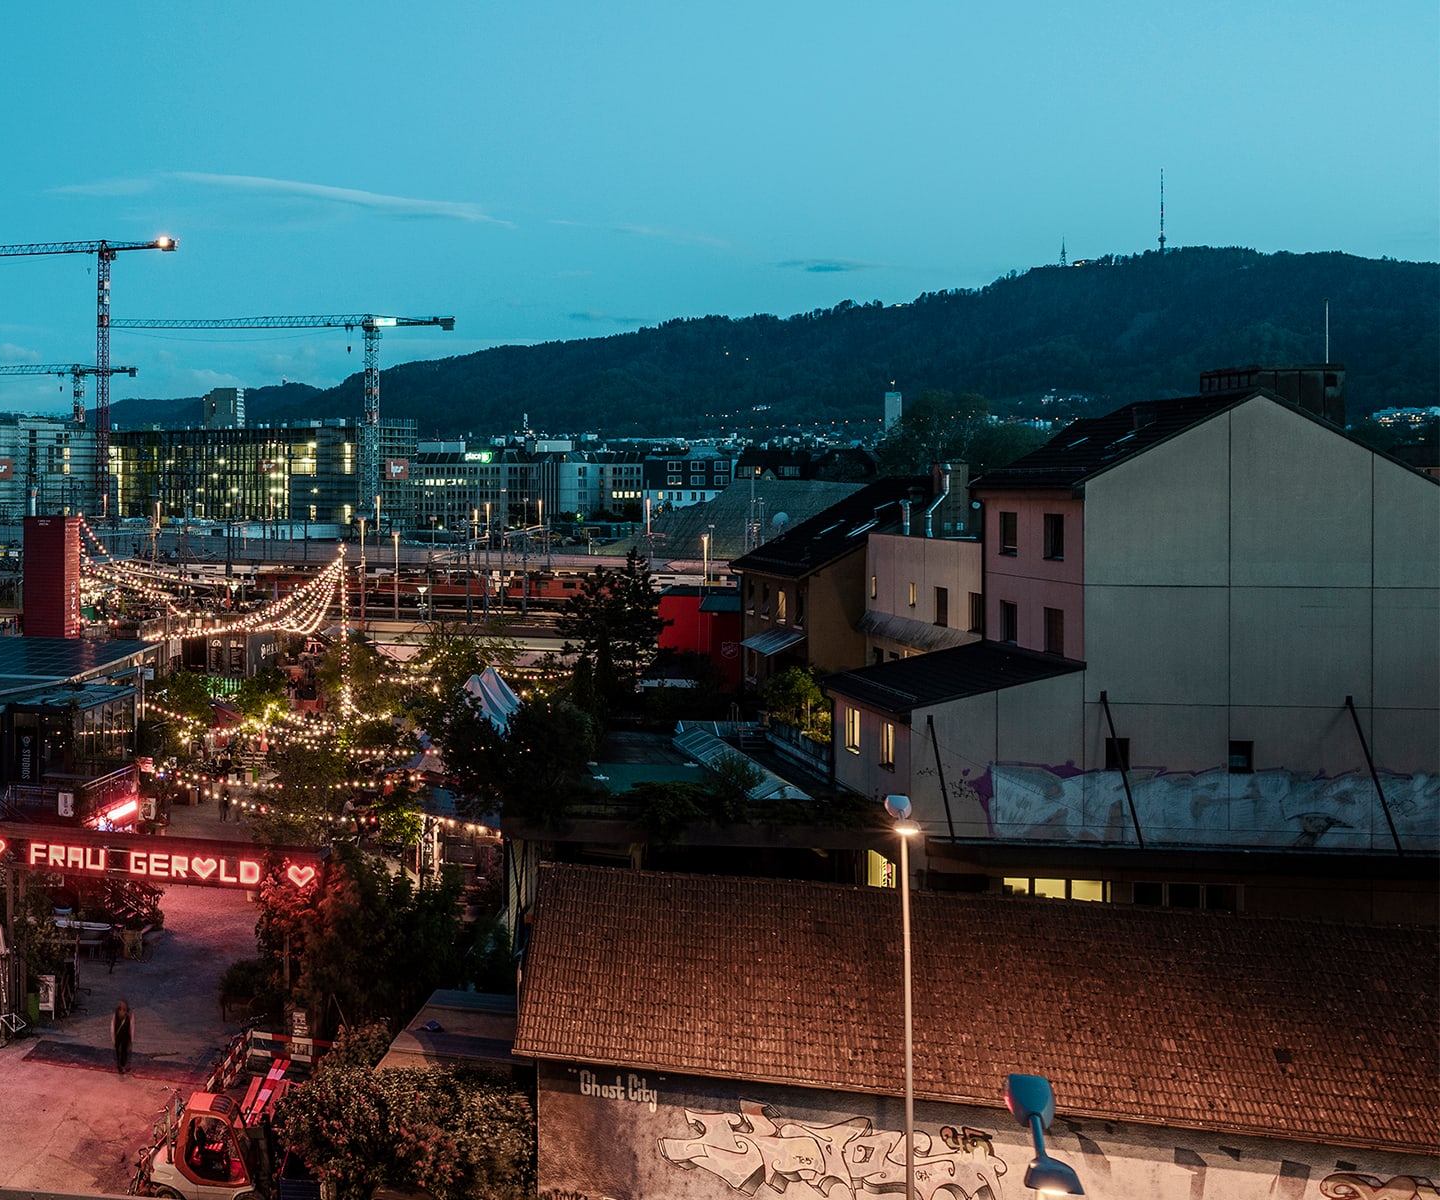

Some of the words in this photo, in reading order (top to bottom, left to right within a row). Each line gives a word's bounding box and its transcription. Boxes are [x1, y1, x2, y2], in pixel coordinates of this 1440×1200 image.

[21, 748, 32, 780] STUDIOS
[29, 843, 106, 871] FRAU
[580, 1069, 625, 1100] Ghost
[628, 1074, 658, 1113] City
